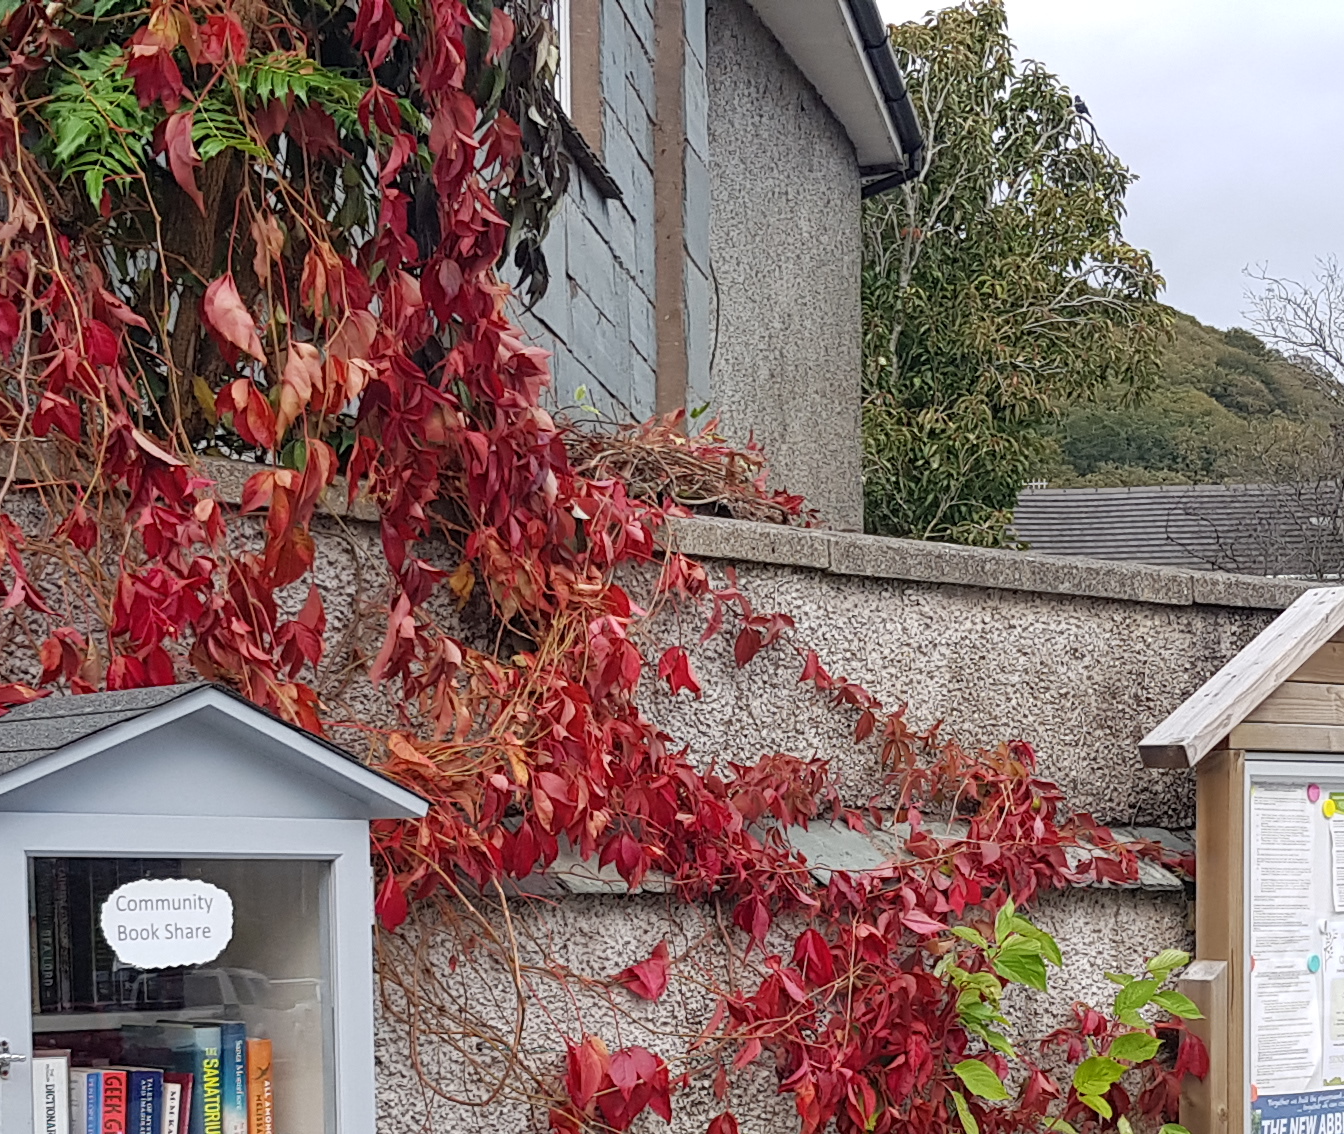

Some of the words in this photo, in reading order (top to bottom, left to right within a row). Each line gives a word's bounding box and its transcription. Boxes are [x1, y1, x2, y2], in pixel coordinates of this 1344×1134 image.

[116, 894, 213, 914] Community
[117, 923, 160, 941] Book
[164, 922, 212, 940] Share
[104, 1075, 122, 1114] GEEK
[145, 1077, 154, 1101] TALES
